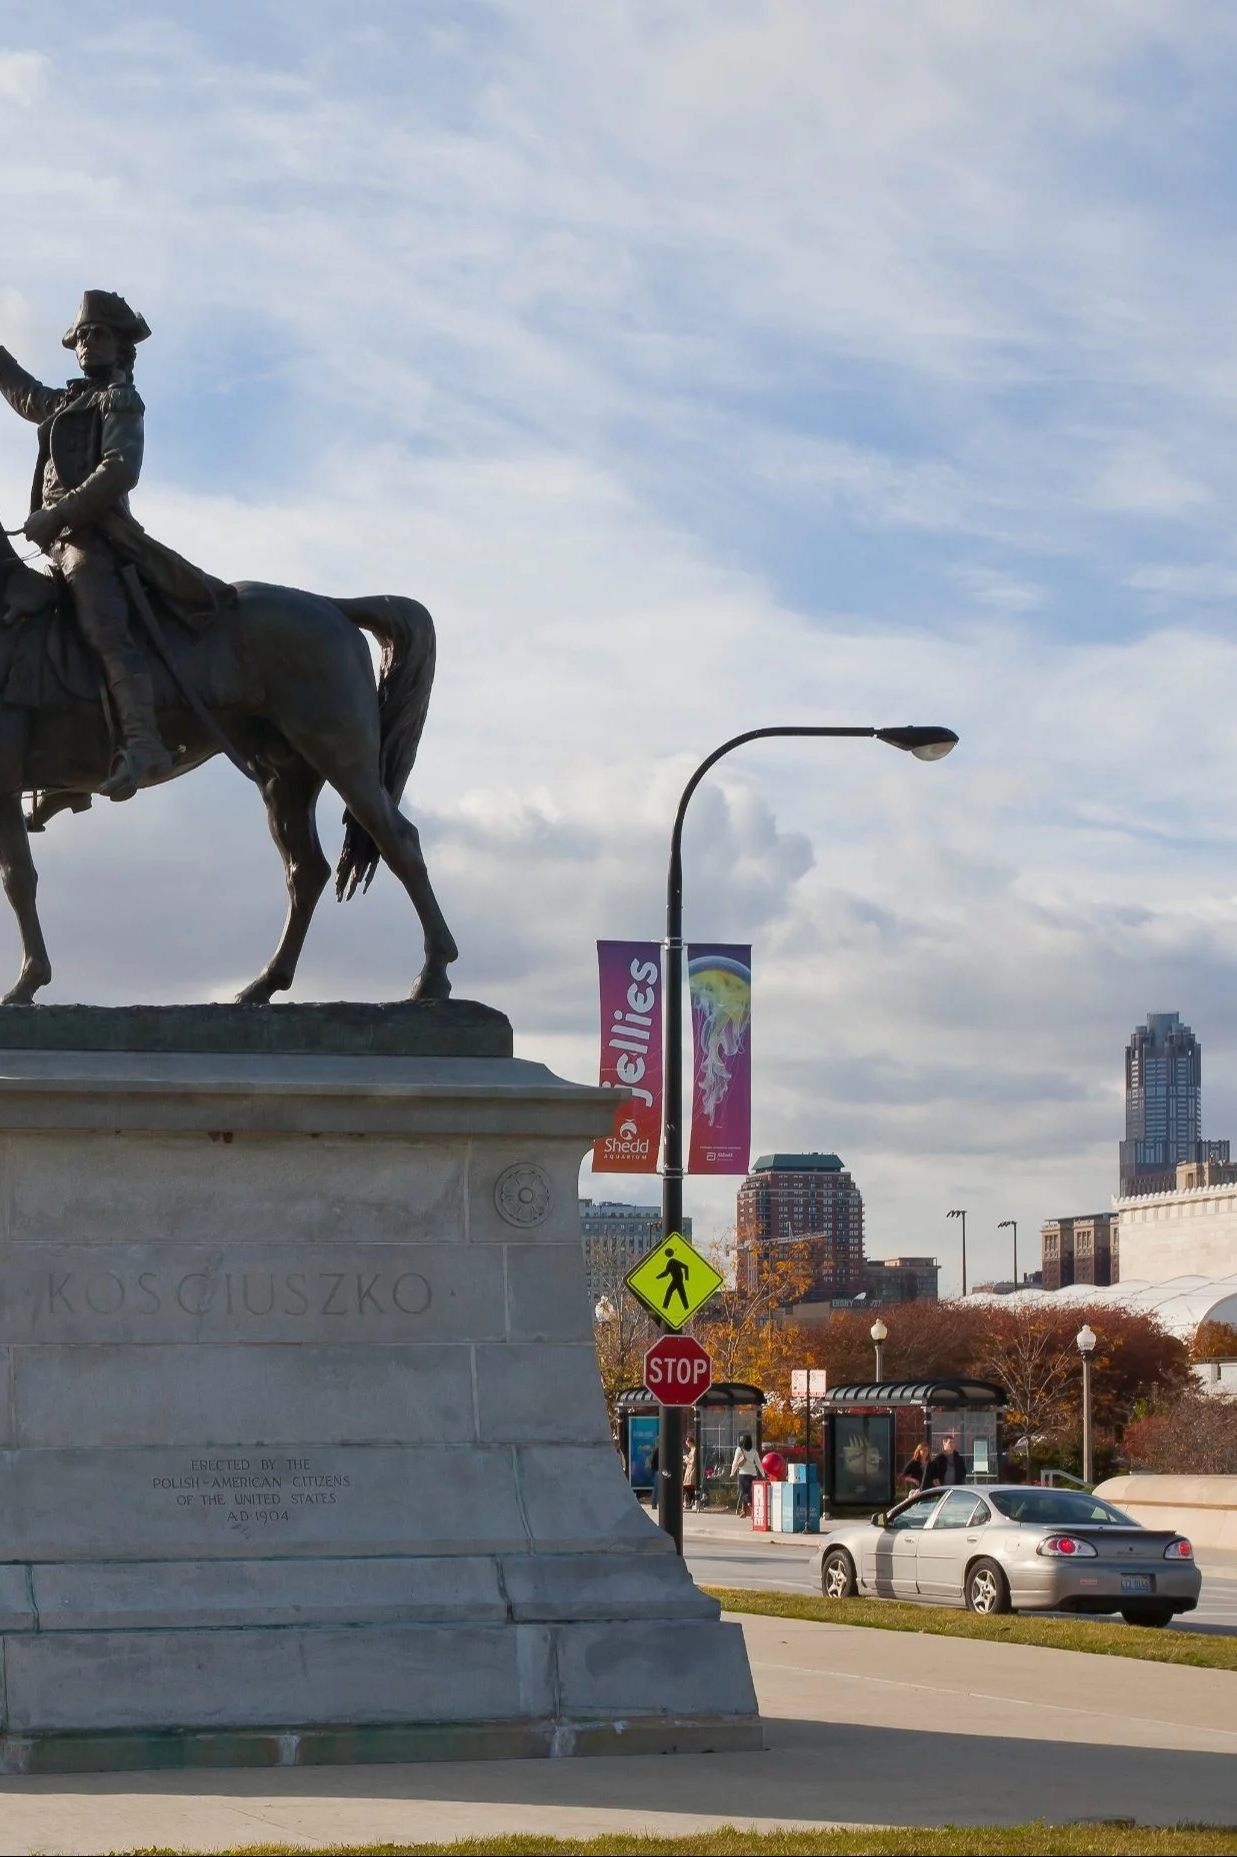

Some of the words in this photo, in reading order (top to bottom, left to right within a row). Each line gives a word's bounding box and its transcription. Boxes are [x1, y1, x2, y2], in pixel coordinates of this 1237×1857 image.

[604, 1138, 649, 1153] Shedd
[47, 1272, 433, 1316] KOSCIUSZKO
[649, 1357, 707, 1384] STOP
[191, 1459, 250, 1472] ERECTED
[261, 1459, 277, 1471] BY
[286, 1458, 311, 1471] THE
[292, 1475, 351, 1488] CITIZENS
[176, 1494, 194, 1507] OF
[201, 1494, 226, 1506] THE
[234, 1493, 281, 1506] UNITED
[291, 1492, 338, 1505] STATES
